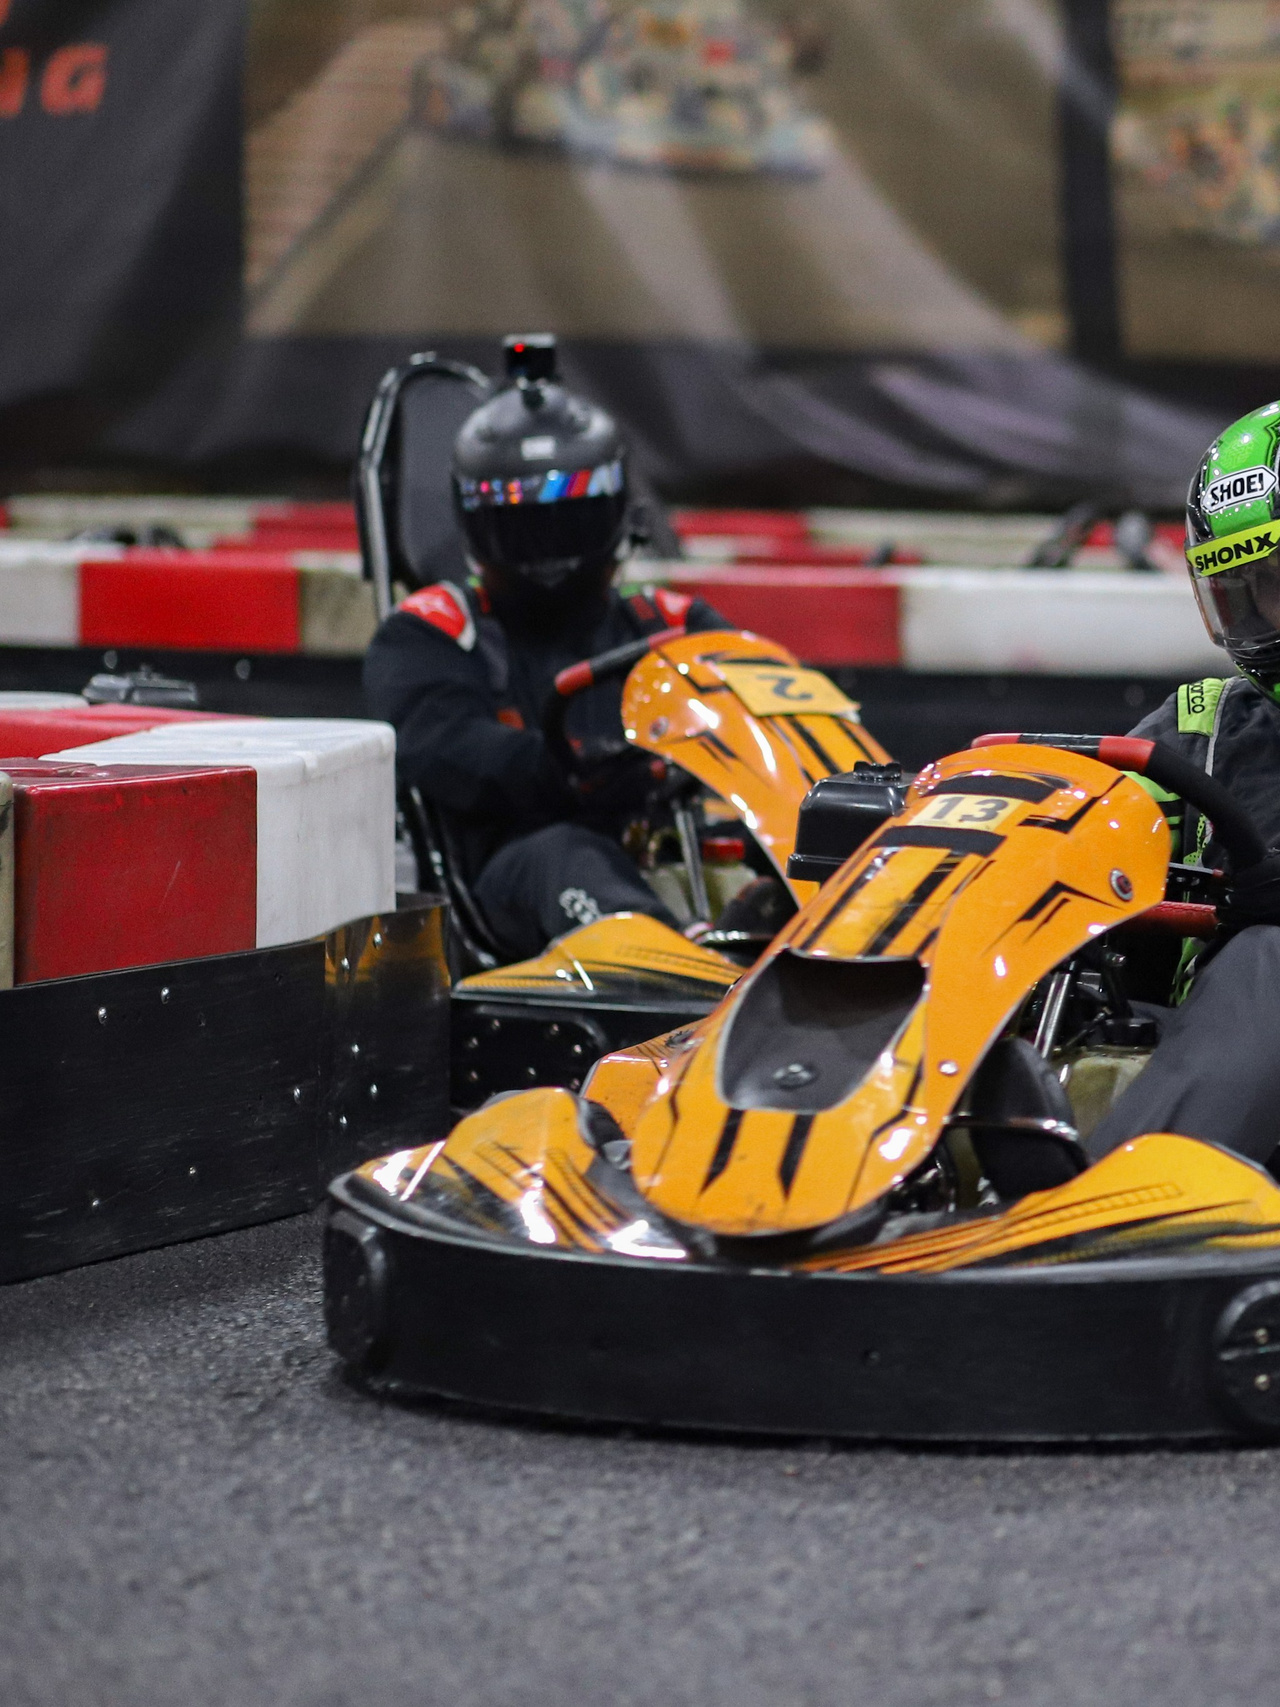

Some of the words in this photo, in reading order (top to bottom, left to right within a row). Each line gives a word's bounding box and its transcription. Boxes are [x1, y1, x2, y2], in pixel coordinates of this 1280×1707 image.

[1210, 473, 1264, 507] SHOEI
[1195, 531, 1278, 572] SHONX
[1188, 681, 1206, 714] arco
[932, 796, 1009, 822] 13
